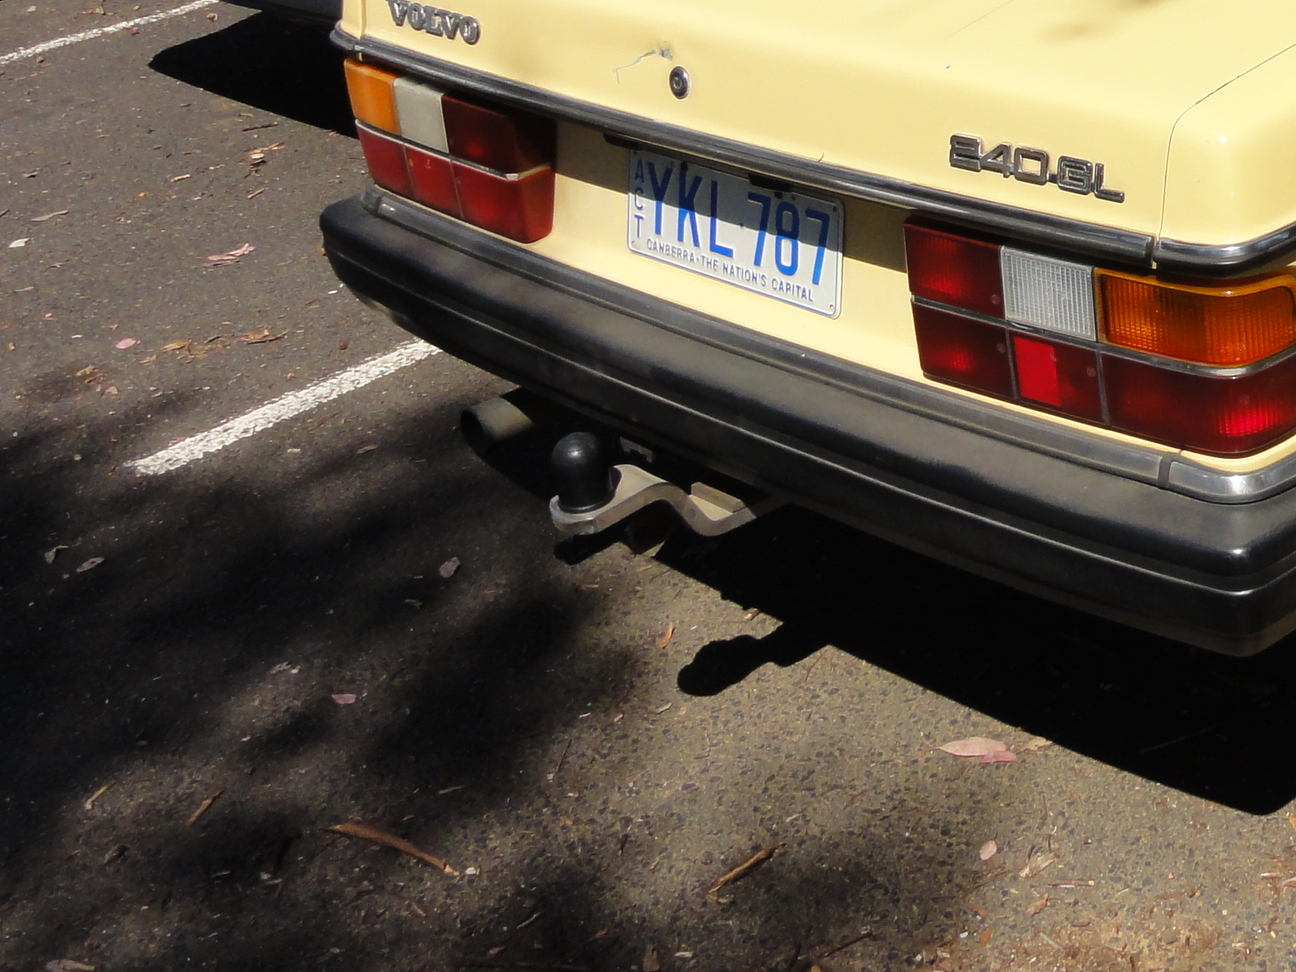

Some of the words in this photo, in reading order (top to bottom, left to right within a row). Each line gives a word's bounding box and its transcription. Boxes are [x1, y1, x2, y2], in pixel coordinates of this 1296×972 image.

[949, 133, 1049, 187] 240
[1057, 154, 1126, 204] GL
[647, 161, 734, 258] YKL
[747, 191, 830, 286] 787
[722, 262, 767, 287] NATION'S
[771, 277, 814, 302] CAPITAL
